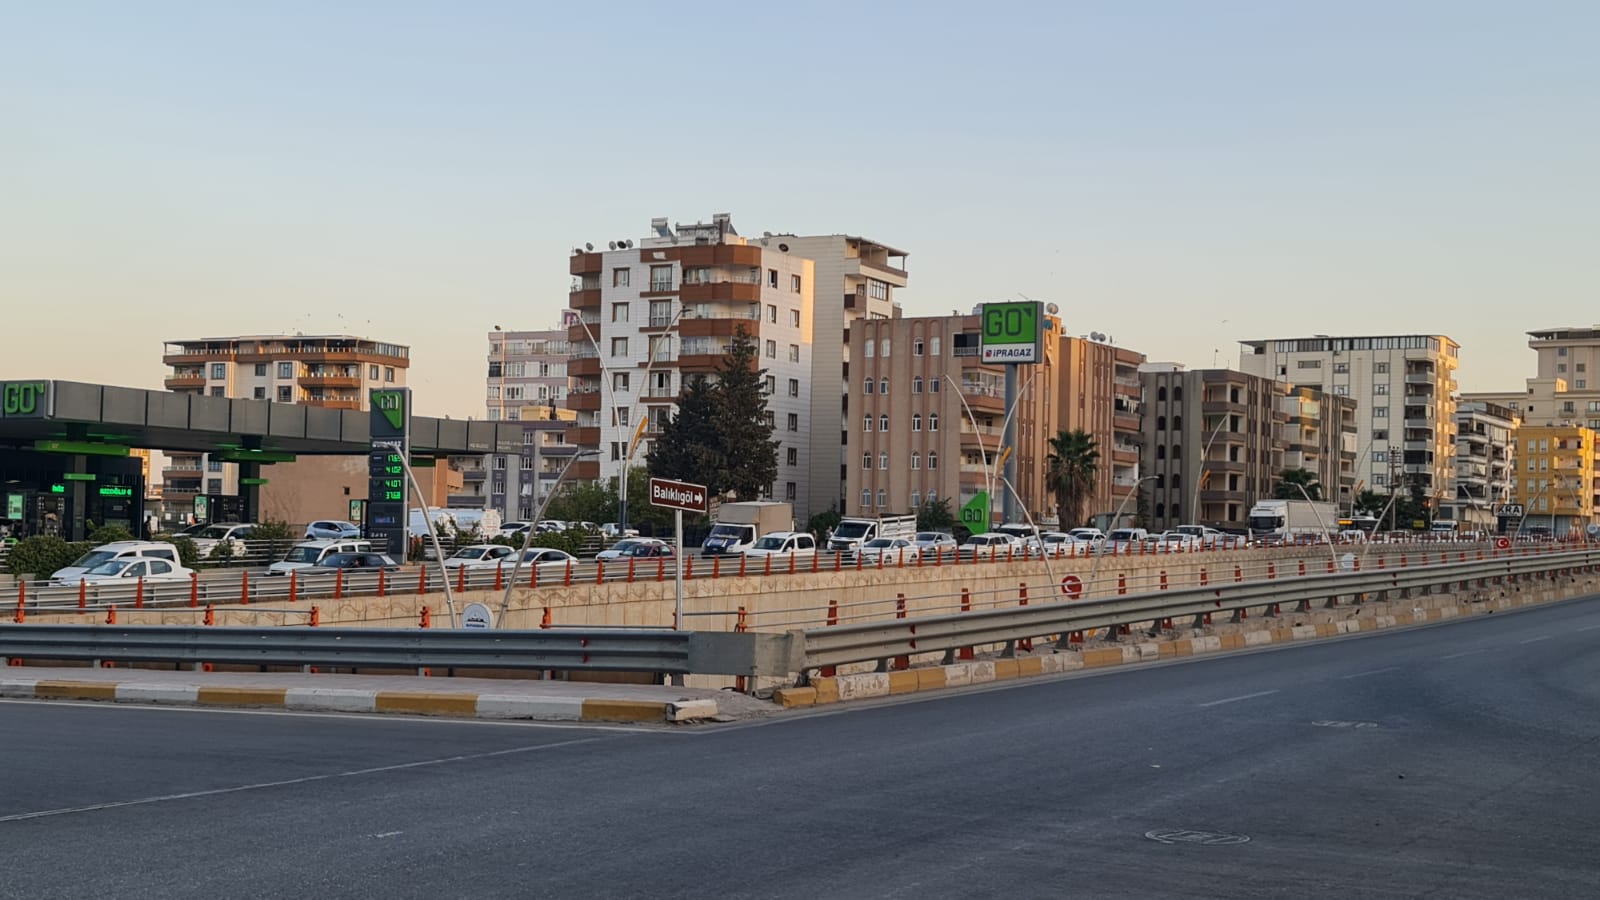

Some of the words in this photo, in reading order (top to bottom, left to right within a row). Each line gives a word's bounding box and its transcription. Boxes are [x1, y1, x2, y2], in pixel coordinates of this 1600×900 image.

[986, 309, 1022, 337] GO
[4, 383, 36, 414] GO
[653, 485, 693, 505] Balıklıgöl
[963, 508, 982, 522] GO
